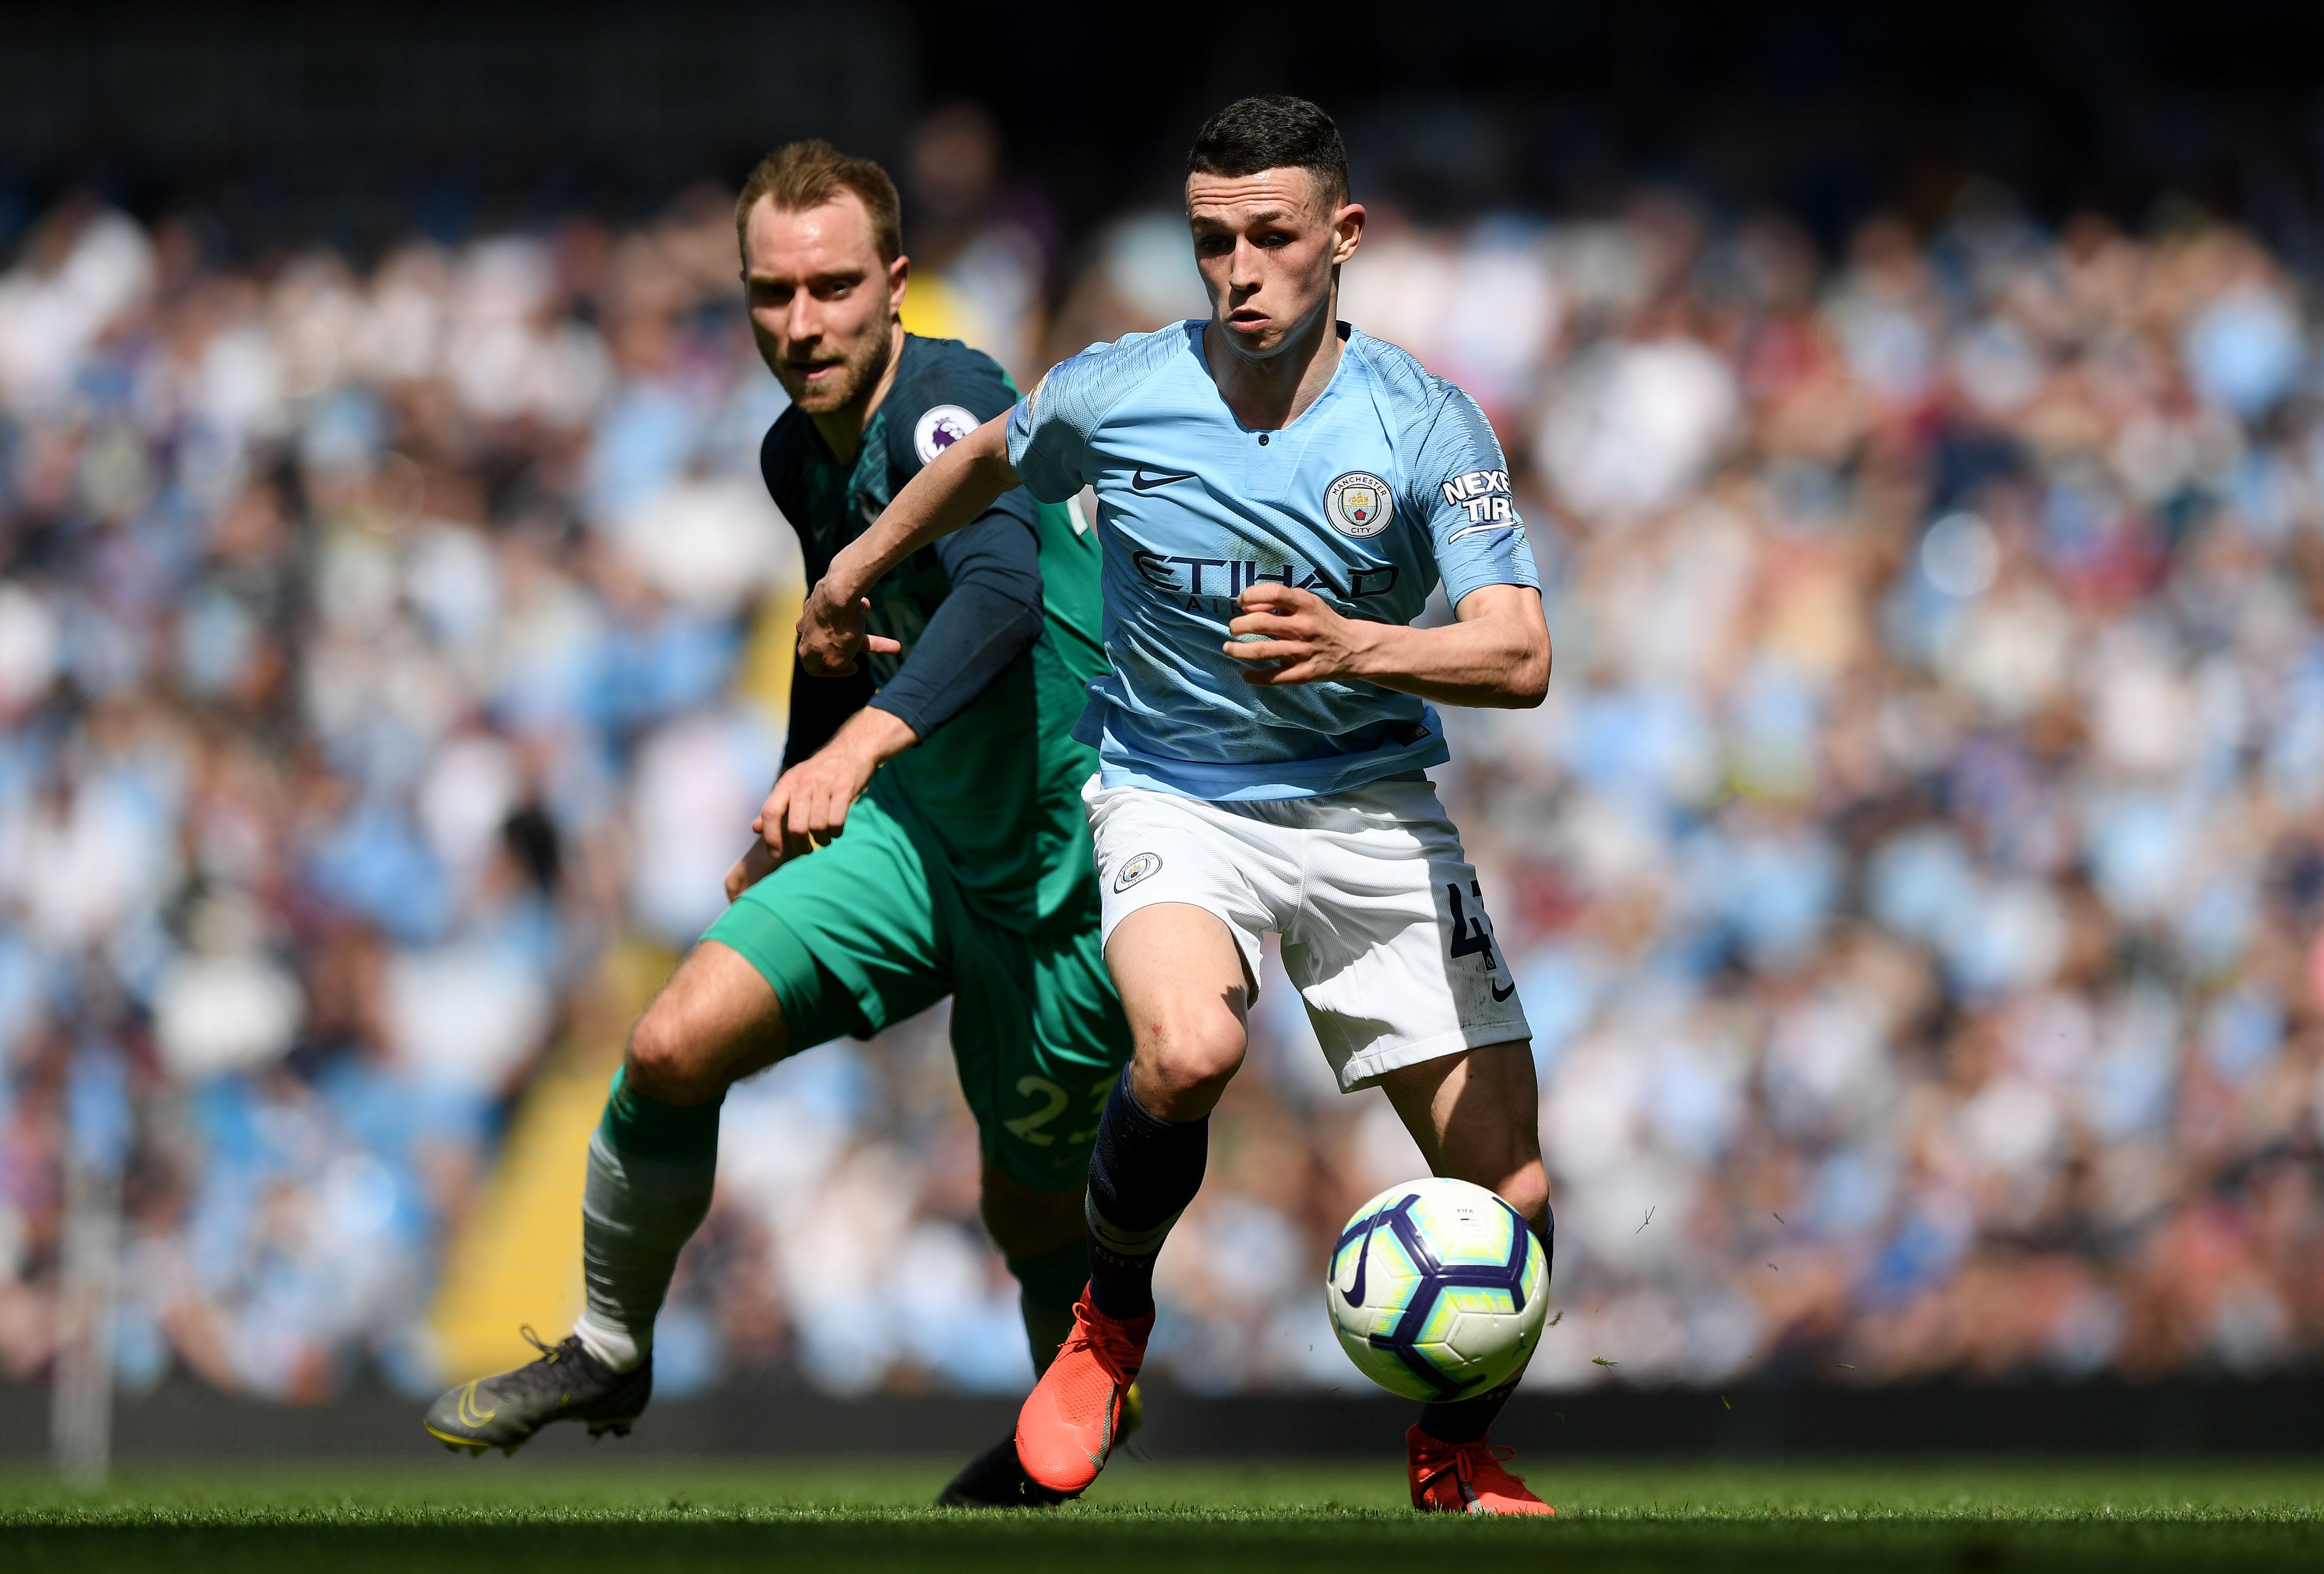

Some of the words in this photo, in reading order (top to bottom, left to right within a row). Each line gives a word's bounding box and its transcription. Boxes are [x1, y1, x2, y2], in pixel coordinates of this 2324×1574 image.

[1332, 476, 1387, 496] MANCHESTER
[1442, 470, 1512, 506] NEXE
[1462, 497, 1513, 522] TIR
[1132, 550, 1400, 599] ETIHAD
[1128, 877, 1142, 886] CITY
